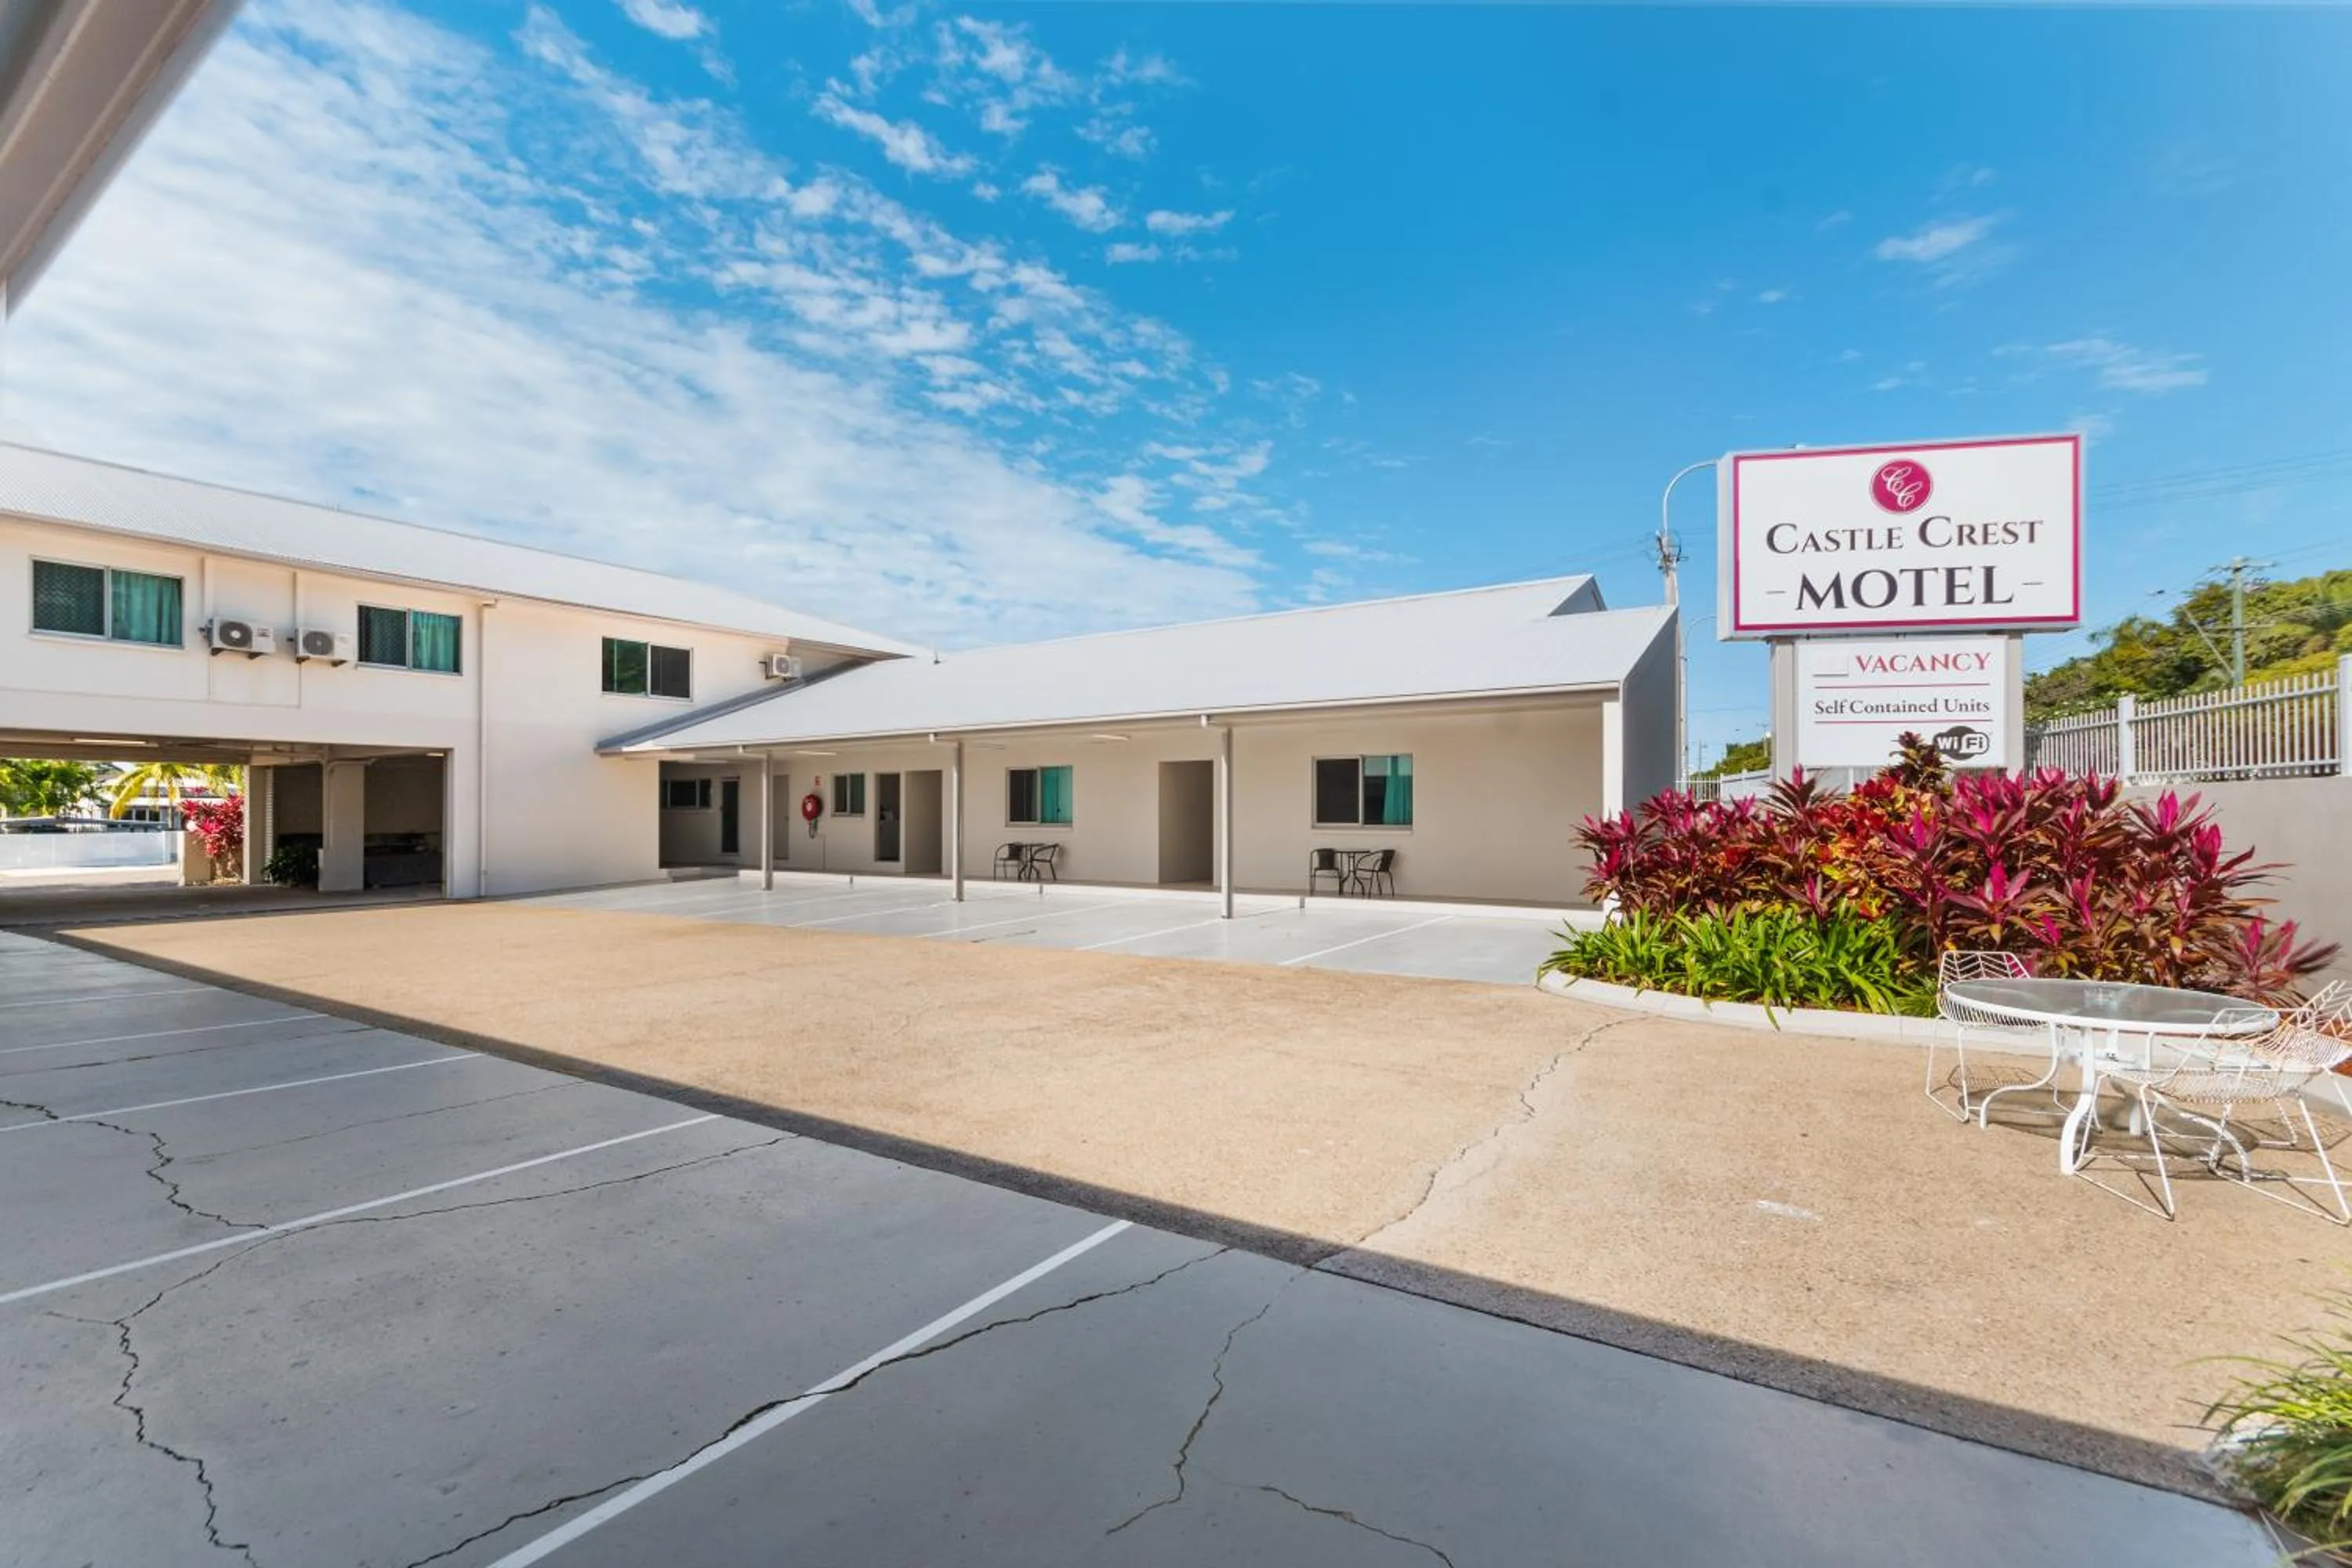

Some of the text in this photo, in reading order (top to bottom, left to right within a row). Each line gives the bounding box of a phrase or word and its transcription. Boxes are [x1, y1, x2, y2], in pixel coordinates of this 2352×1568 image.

[1796, 565, 2014, 610] MOTEL
[1856, 652, 1991, 673] VACANCY
[1814, 698, 1991, 715] Self Contained Units
